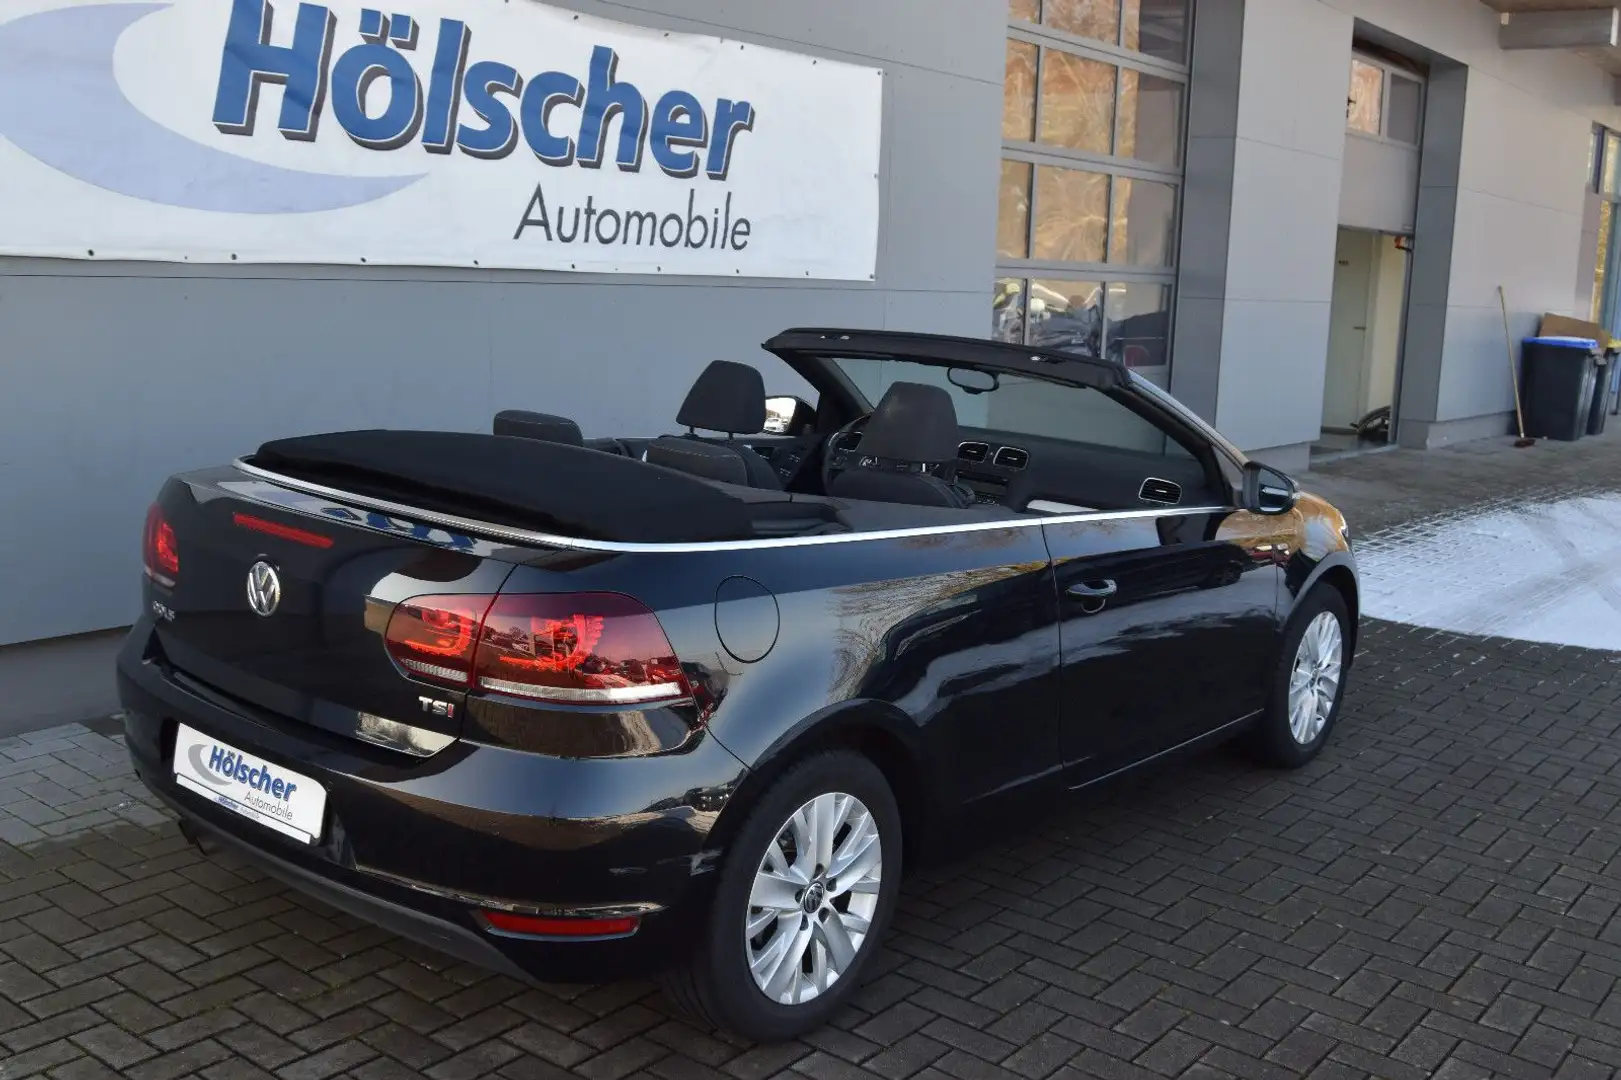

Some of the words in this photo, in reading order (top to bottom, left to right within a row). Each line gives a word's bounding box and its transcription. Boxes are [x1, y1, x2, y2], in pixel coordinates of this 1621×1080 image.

[212, 0, 756, 181] Hölscher
[513, 181, 750, 250] Automobile
[418, 695, 454, 718] TSI
[208, 744, 297, 802] Hölscher
[244, 791, 293, 820] Automobile
